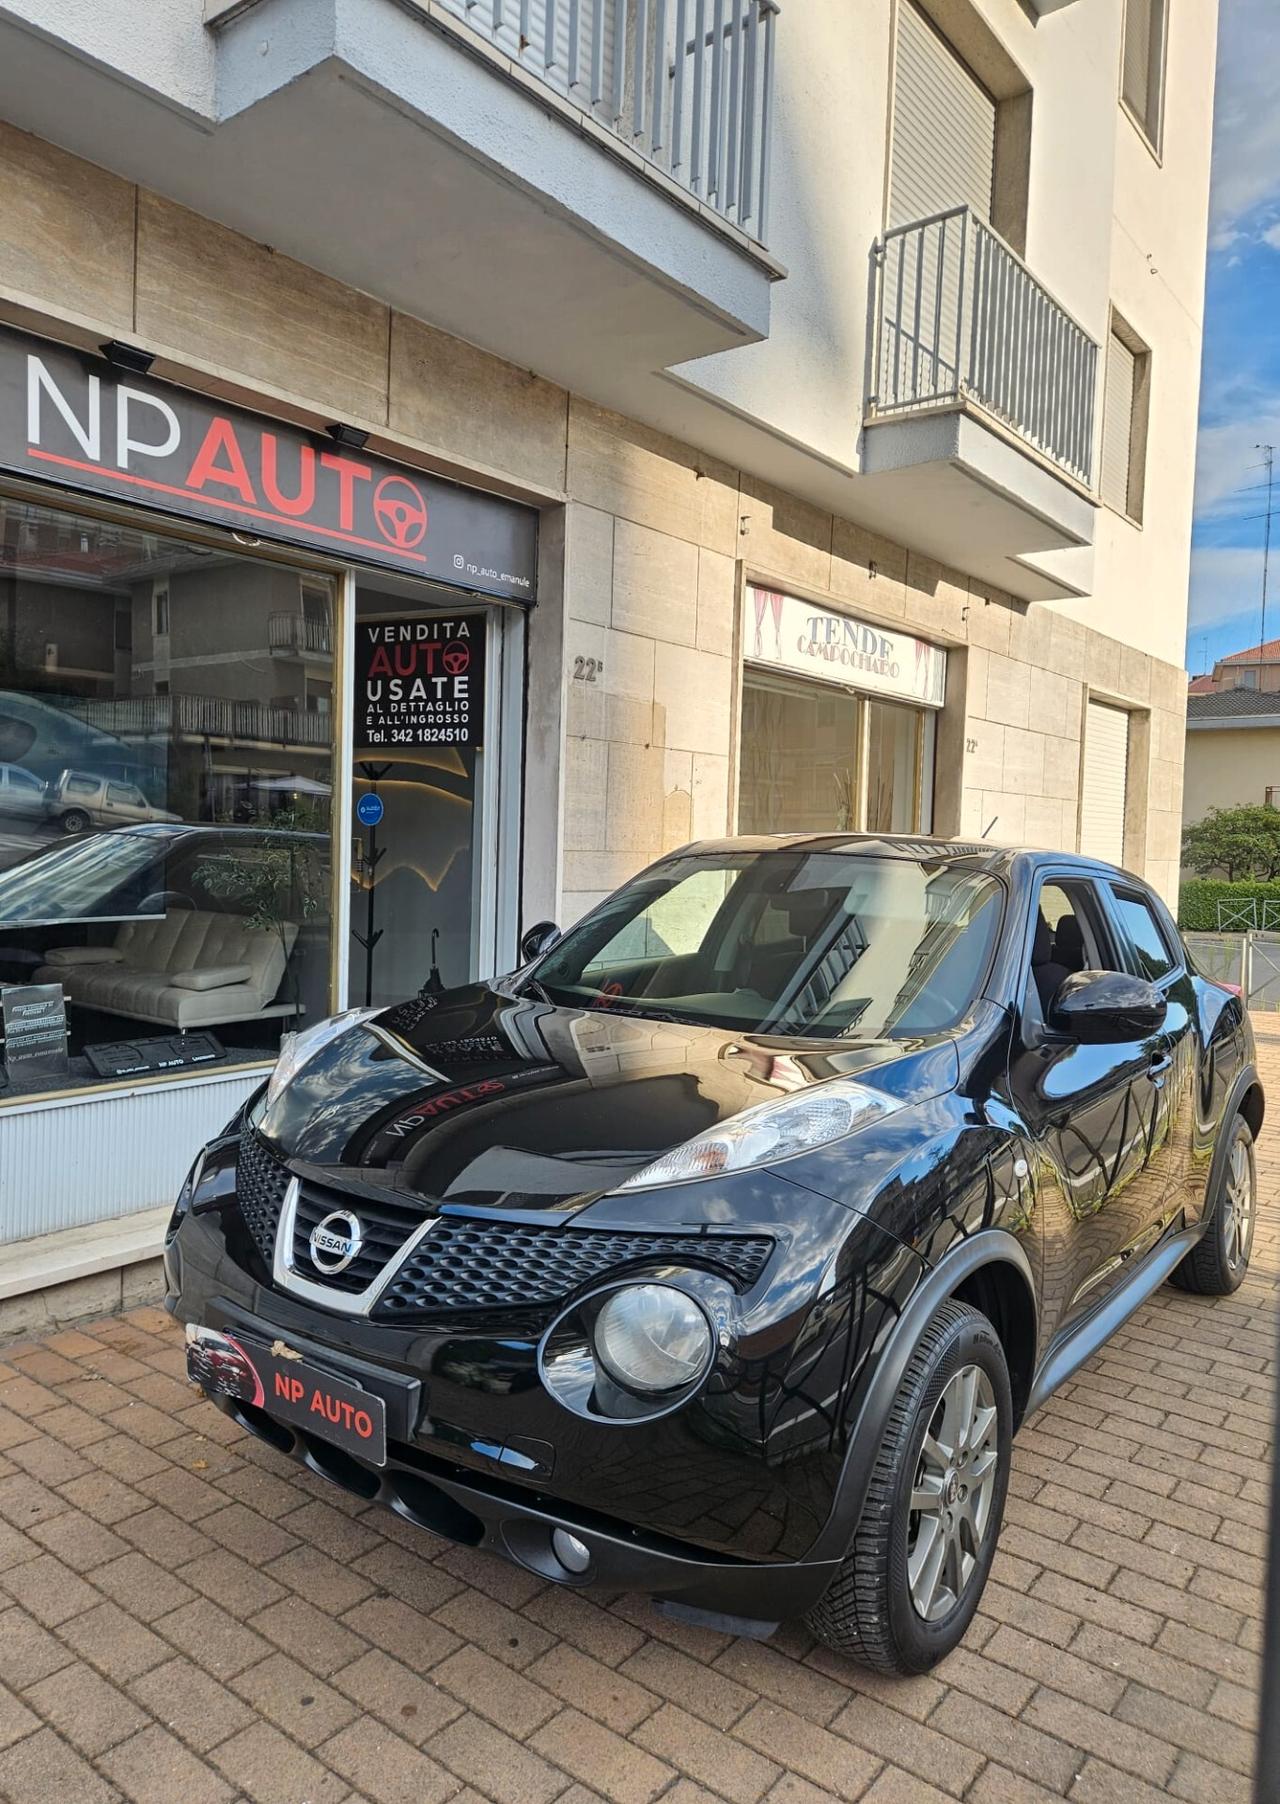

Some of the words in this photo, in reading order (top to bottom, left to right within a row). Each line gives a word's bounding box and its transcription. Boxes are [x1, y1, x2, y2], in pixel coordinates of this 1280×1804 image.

[367, 621, 470, 643] VENDITA
[366, 675, 469, 701] USATE
[367, 703, 383, 713] AL
[391, 700, 469, 713] DETTAGLIO
[366, 715, 373, 725] E
[378, 713, 469, 725] ALL'INGROSSO
[367, 729, 388, 743] Tel.
[391, 729, 413, 742] 342
[416, 727, 469, 742] 1824510
[313, 1231, 353, 1254] NISSAN
[274, 1372, 304, 1404] NP
[310, 1389, 373, 1439] AUTO
